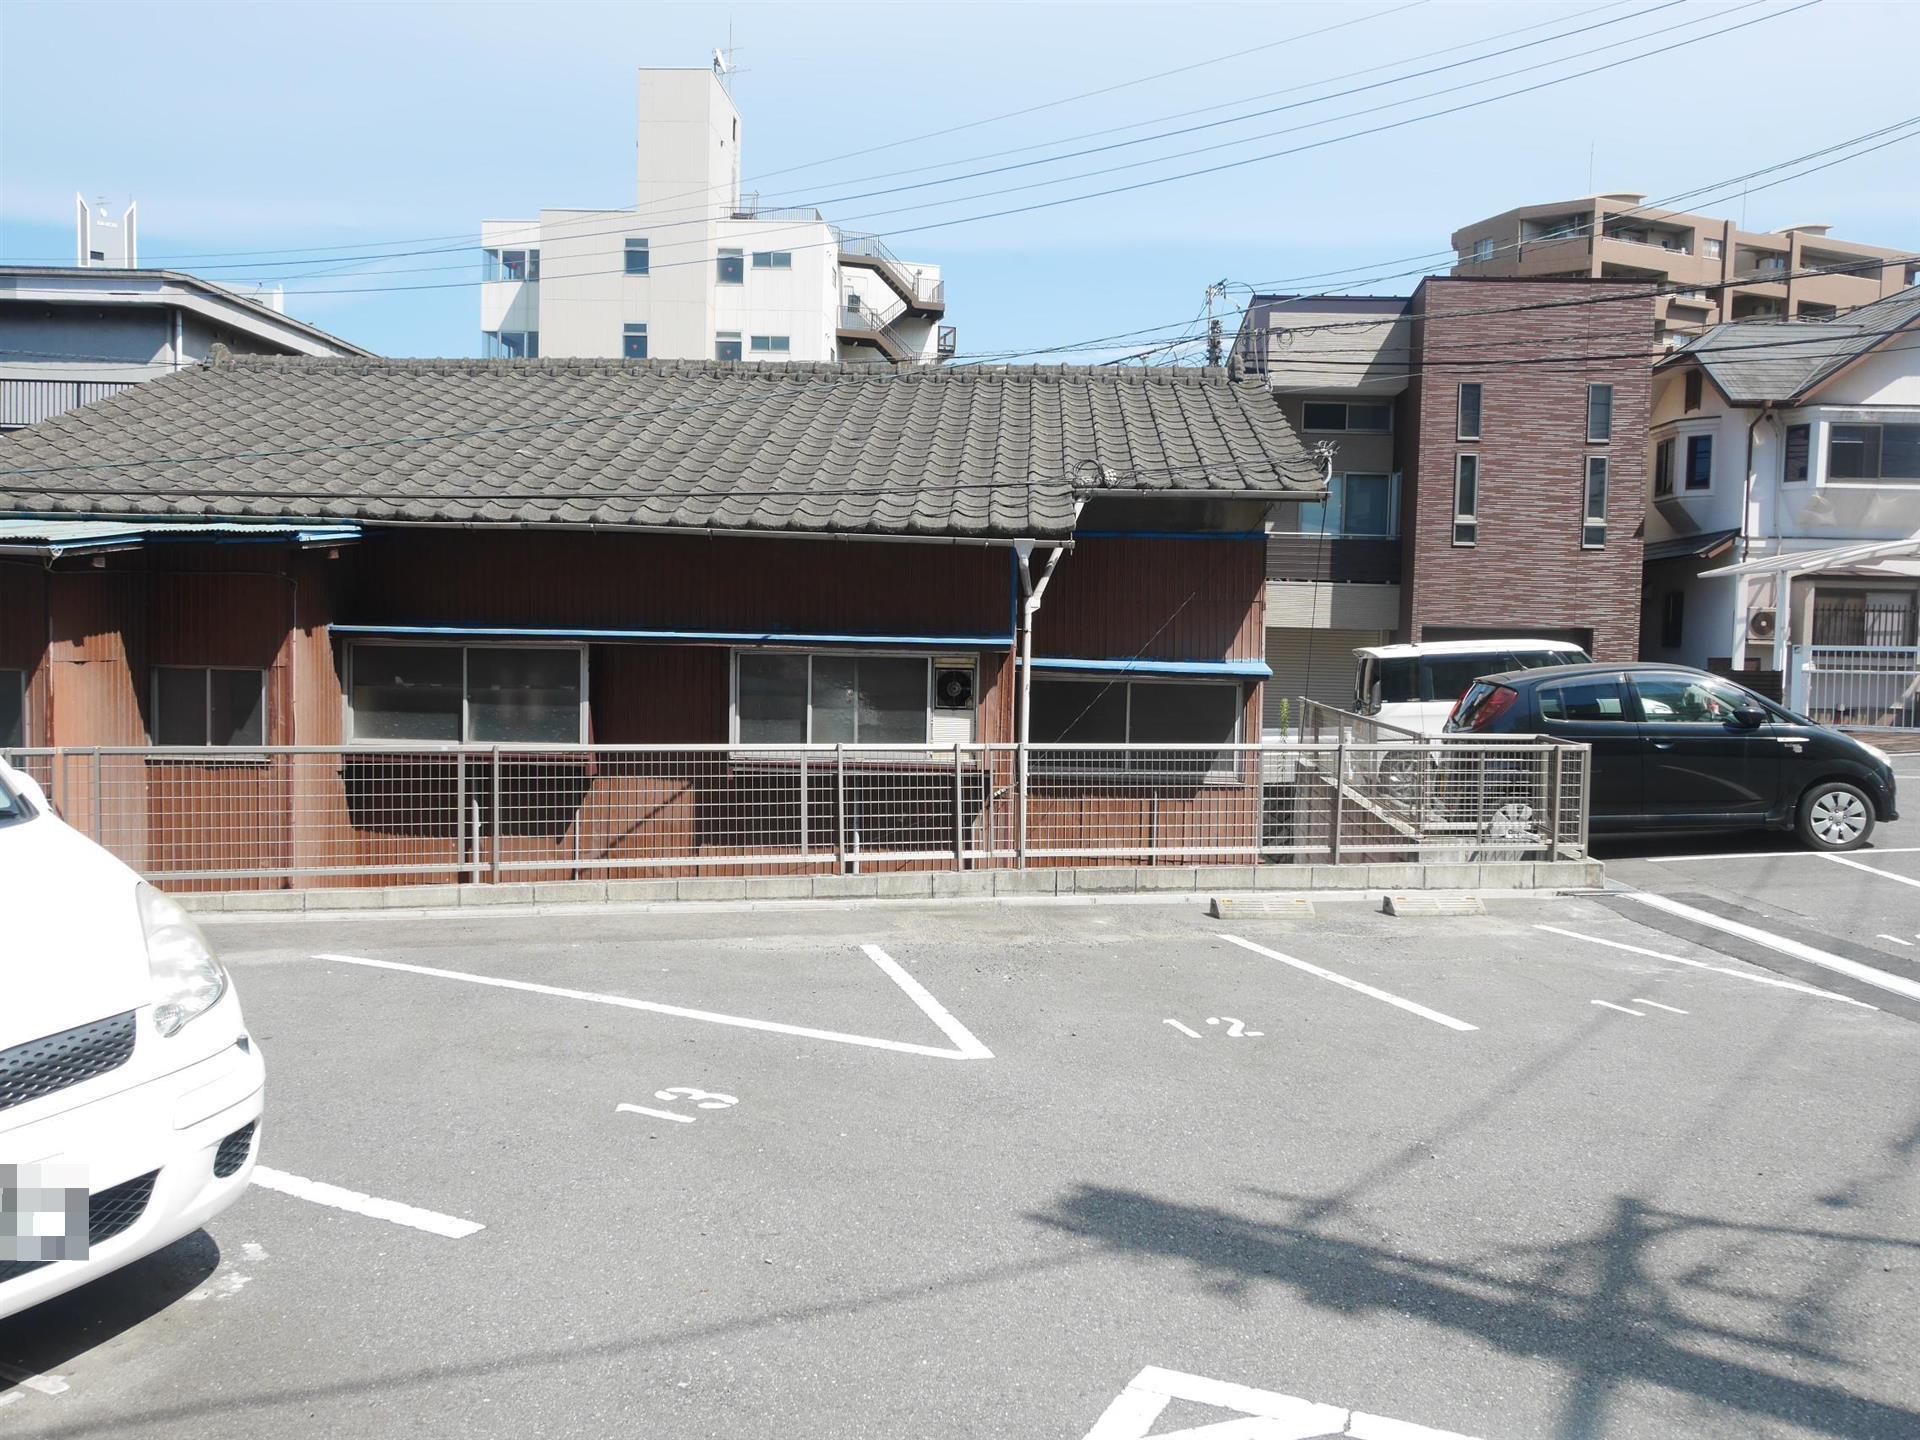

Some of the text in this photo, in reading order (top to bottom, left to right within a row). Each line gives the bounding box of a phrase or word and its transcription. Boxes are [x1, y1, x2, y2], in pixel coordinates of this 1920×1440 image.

[1591, 998, 1689, 1016] 11
[1162, 1016, 1265, 1039] 12
[615, 1087, 739, 1123] 13
